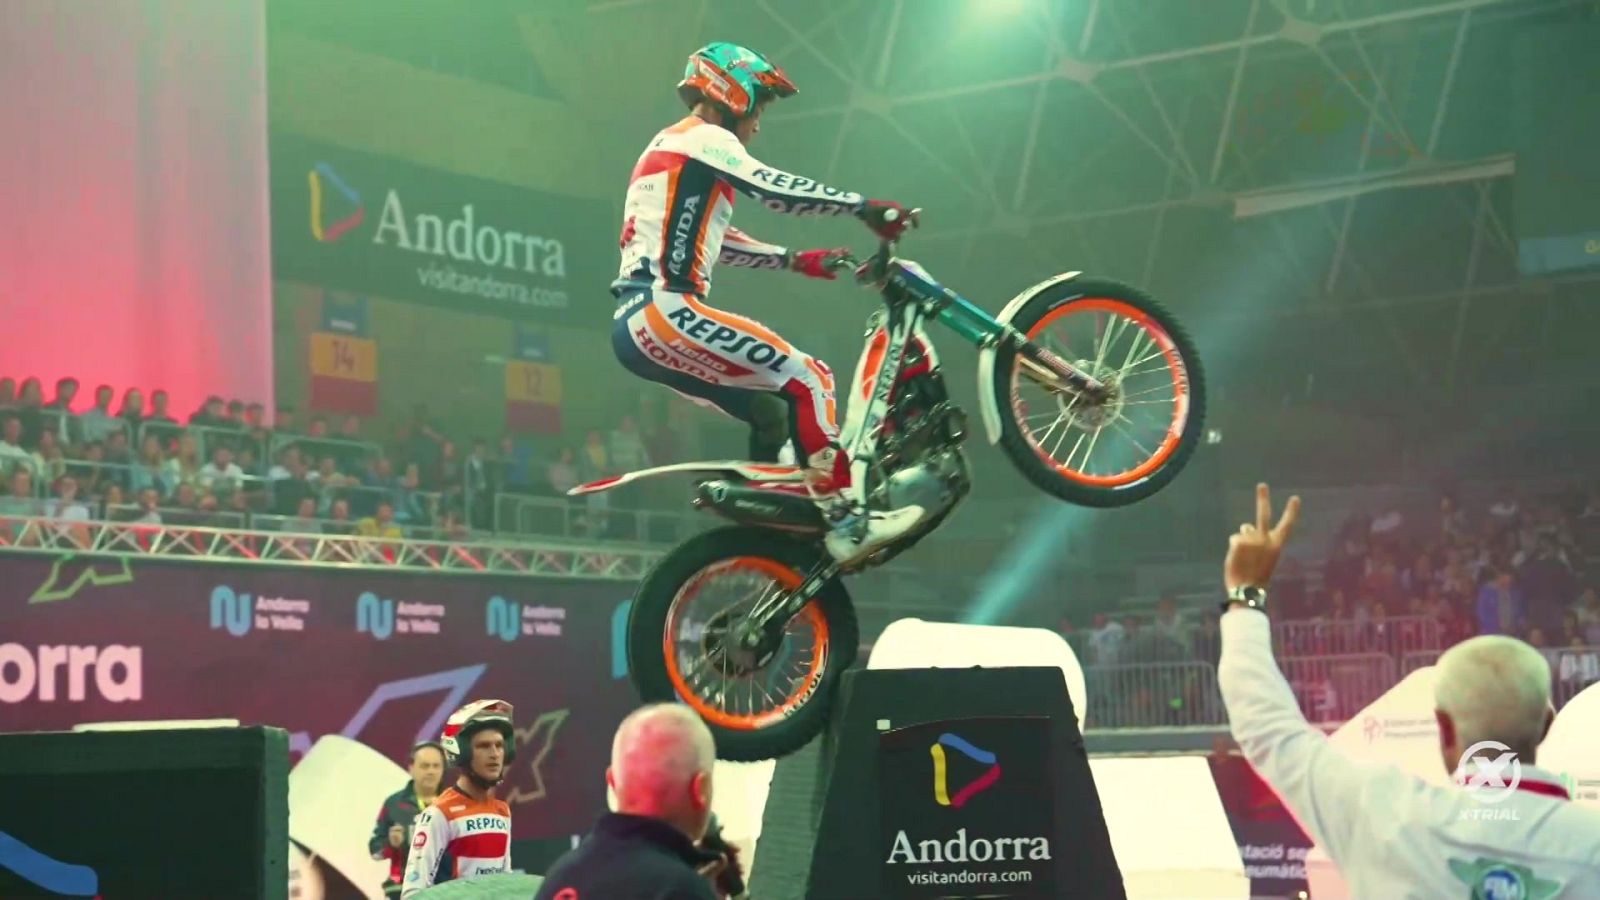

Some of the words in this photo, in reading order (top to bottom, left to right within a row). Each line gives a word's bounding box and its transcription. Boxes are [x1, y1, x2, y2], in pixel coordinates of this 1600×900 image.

[752, 167, 855, 198] REPSOL
[372, 188, 567, 277] Andorra
[668, 194, 700, 275] HONDA
[416, 262, 568, 307] visitandorra.com
[635, 326, 721, 385] HONDA
[668, 306, 790, 373] REPSOL
[0, 642, 142, 703] orra
[886, 828, 1052, 864] Andorra
[907, 870, 1033, 885] visitandorra.com
